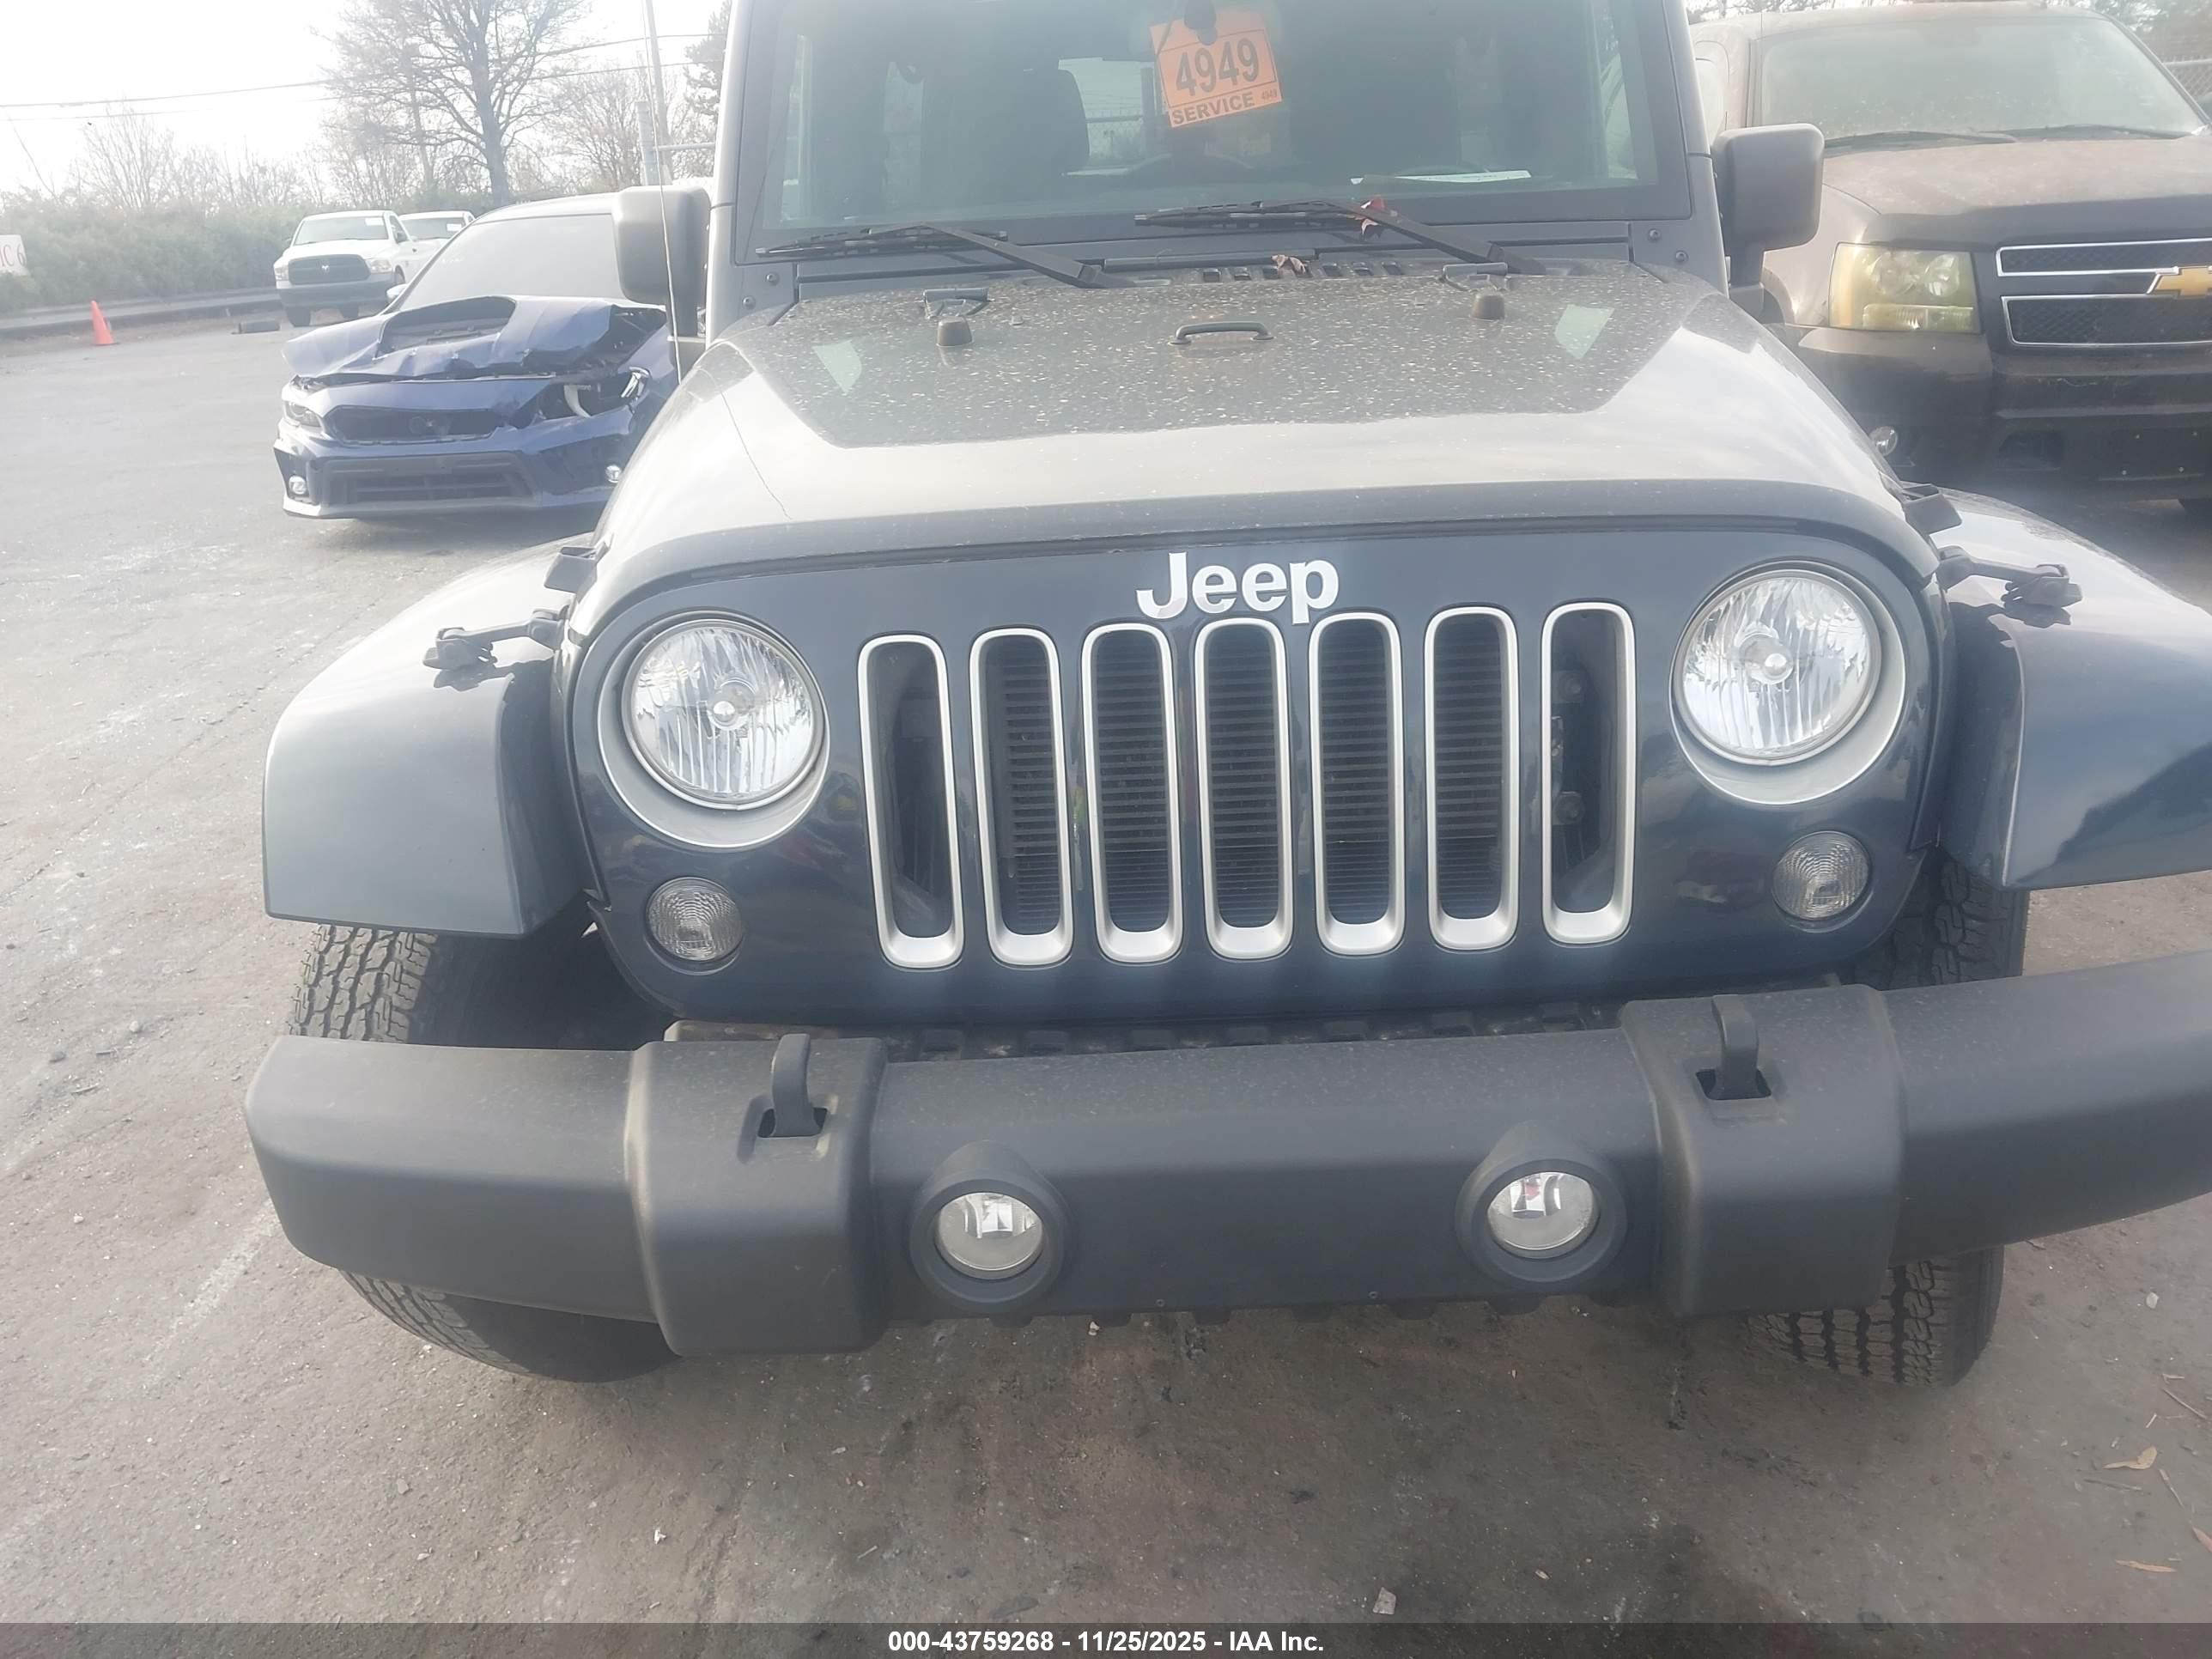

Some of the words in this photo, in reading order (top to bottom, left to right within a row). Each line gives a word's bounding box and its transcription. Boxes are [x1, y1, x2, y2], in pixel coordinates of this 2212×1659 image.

[1176, 38, 1260, 97] 4949
[1171, 91, 1255, 125] SERVICE
[1136, 551, 1340, 625] Jeep
